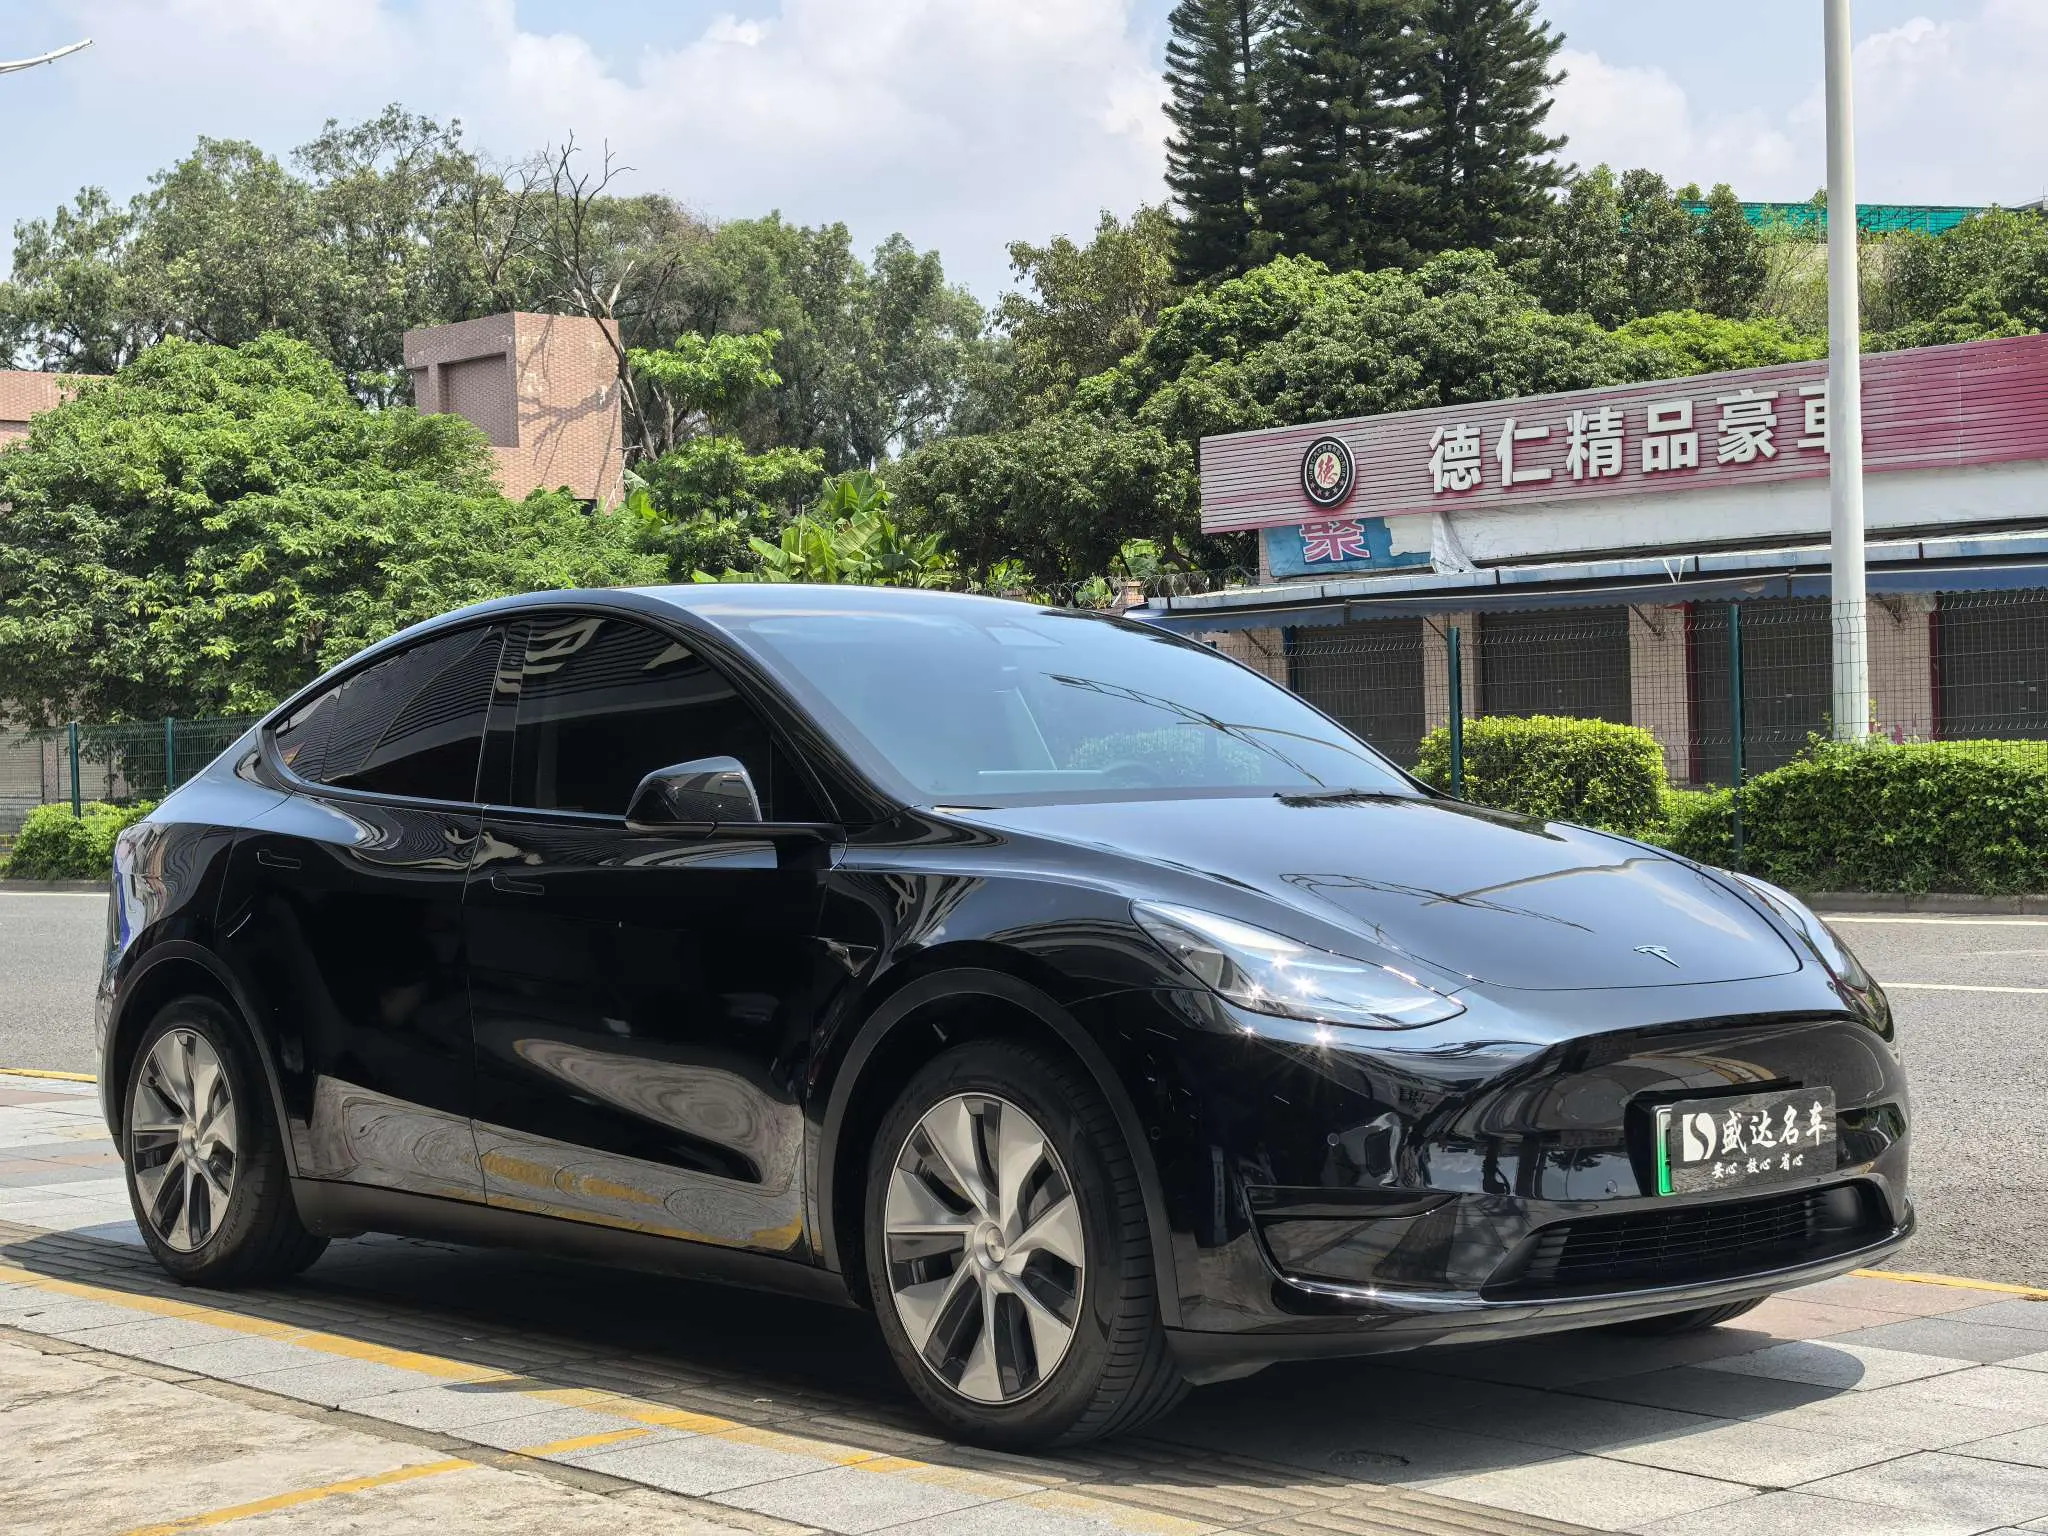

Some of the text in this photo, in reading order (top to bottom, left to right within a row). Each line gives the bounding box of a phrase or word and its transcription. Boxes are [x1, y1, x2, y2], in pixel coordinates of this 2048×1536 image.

[1721, 1100, 1827, 1154] 盛达名车
[1711, 1161, 1738, 1179] 安心
[1779, 1152, 1804, 1170] 省心
